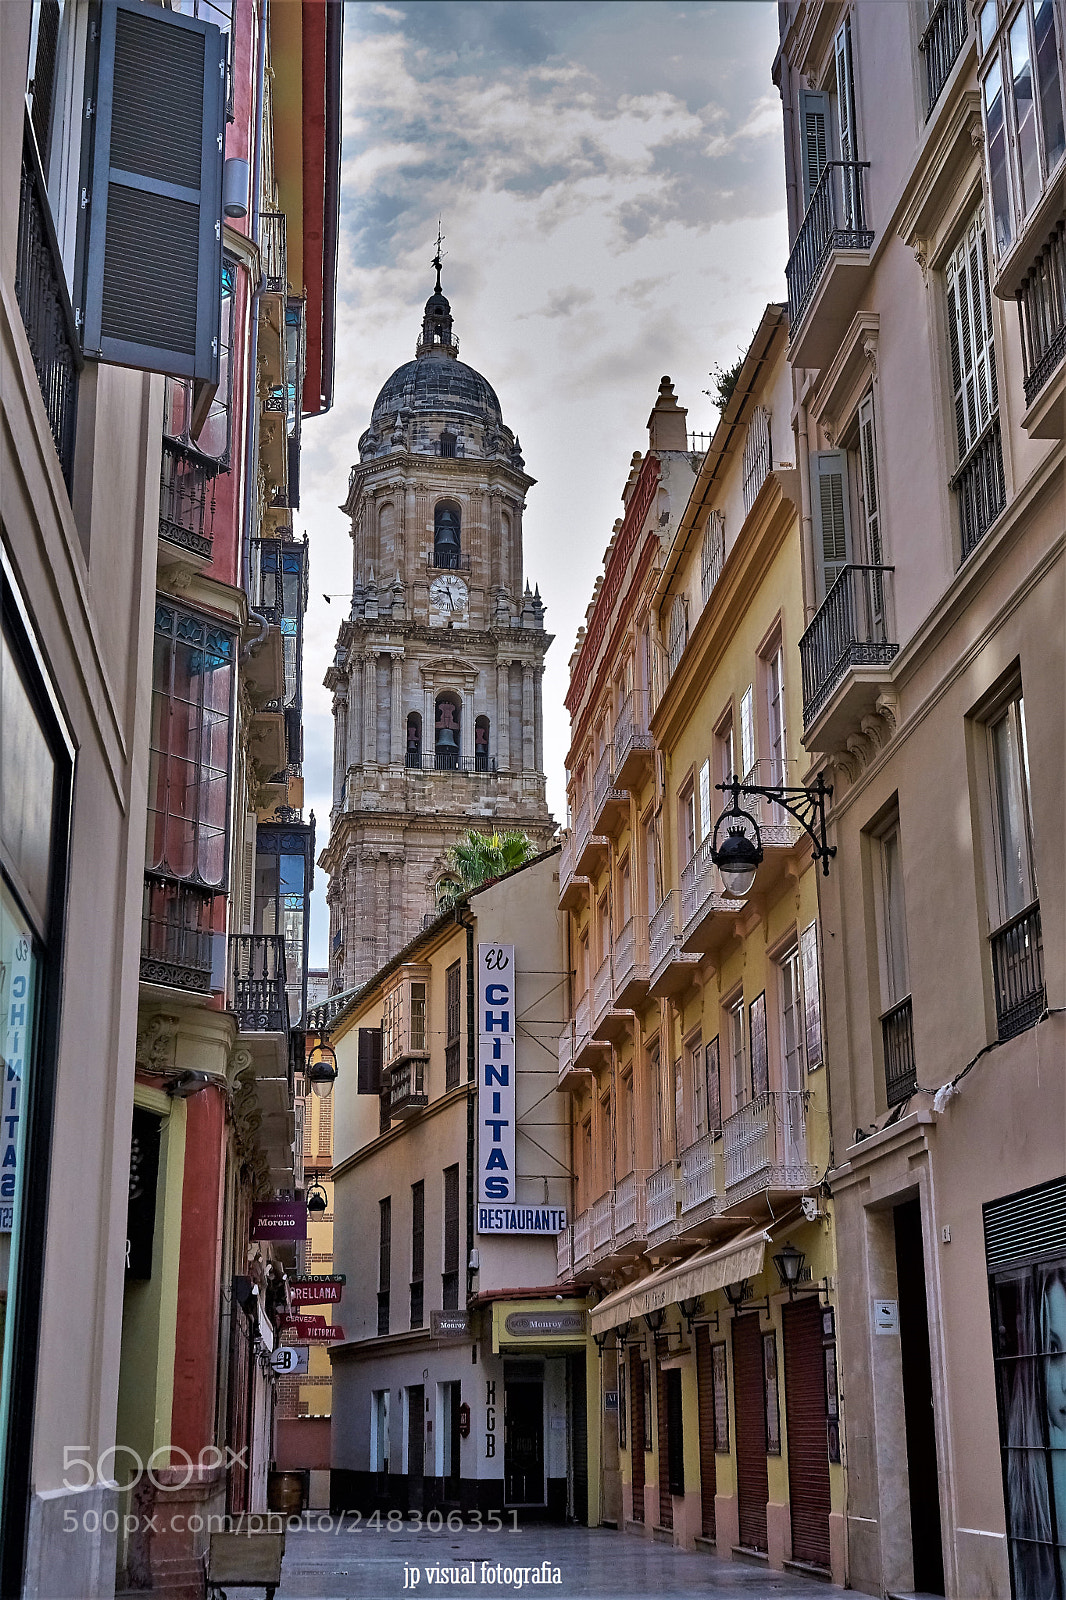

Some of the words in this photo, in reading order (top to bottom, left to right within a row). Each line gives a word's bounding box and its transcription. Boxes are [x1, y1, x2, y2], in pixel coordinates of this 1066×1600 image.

[485, 949, 509, 970] El
[484, 983, 510, 1199] CHINITAS
[257, 1218, 296, 1227] Moreno
[479, 1207, 566, 1231] RESTAURANTE
[285, 1315, 317, 1323] CERVEZA
[440, 1322, 466, 1330] Monroy
[529, 1320, 563, 1329] Monroy
[307, 1327, 336, 1337] VICTORIA
